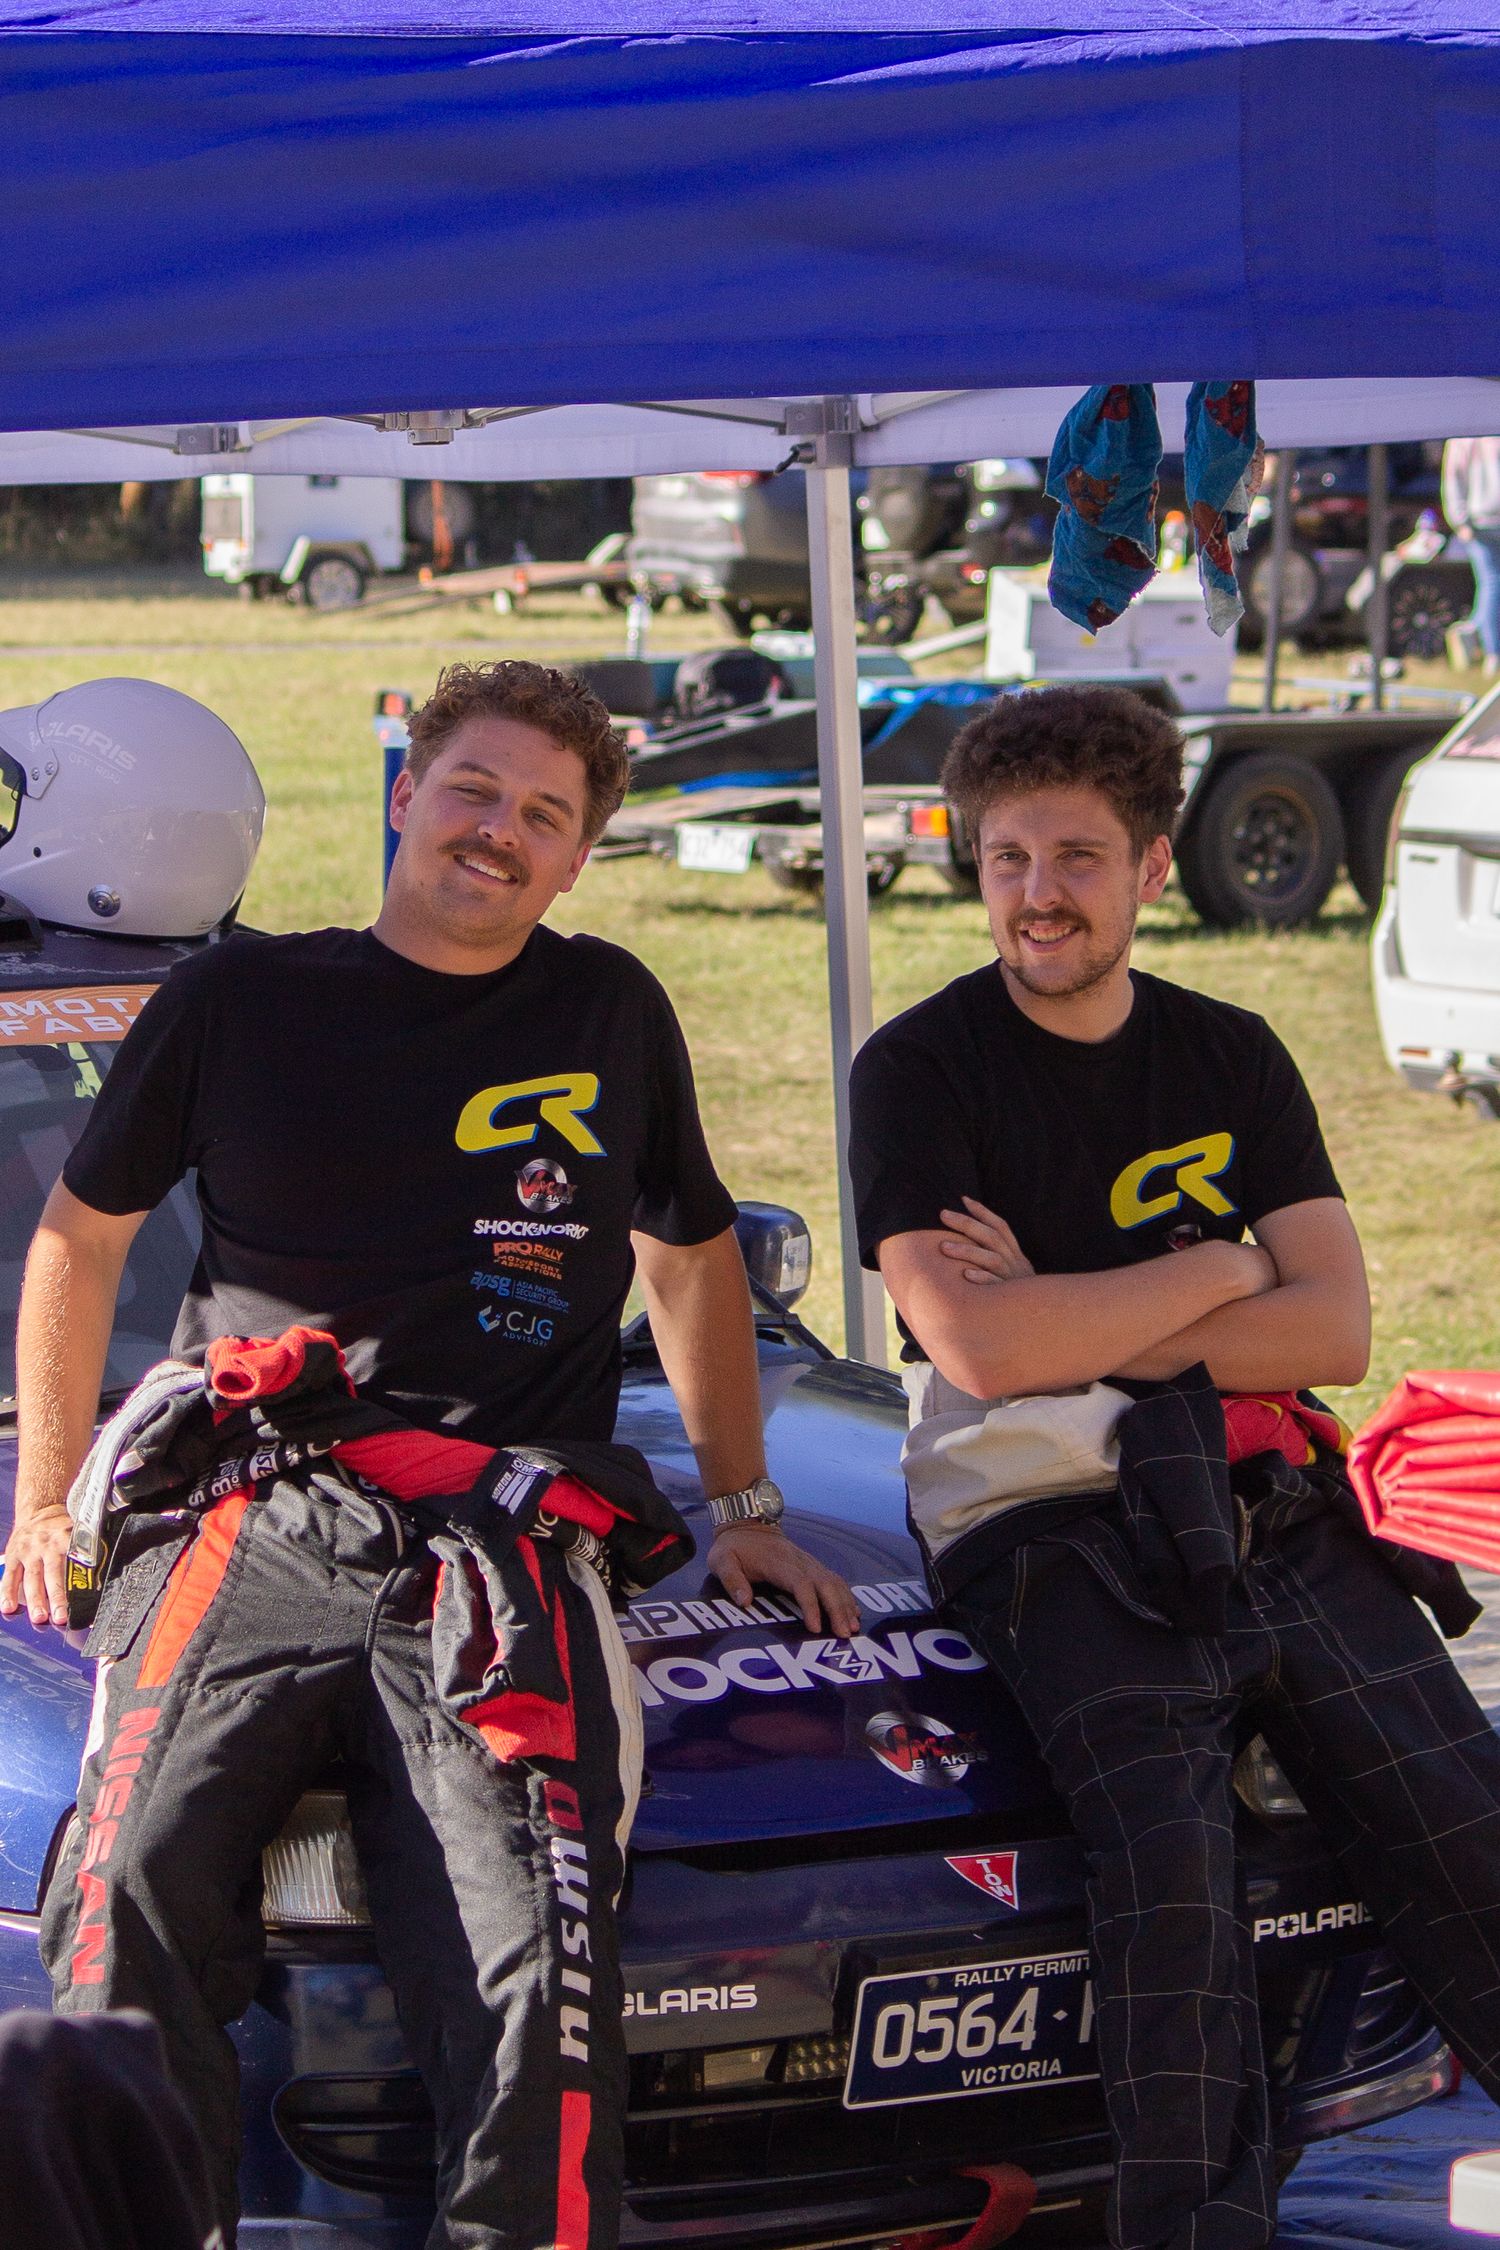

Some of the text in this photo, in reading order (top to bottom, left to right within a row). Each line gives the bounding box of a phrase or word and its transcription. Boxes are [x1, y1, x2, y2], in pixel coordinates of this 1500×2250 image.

[0, 1015, 137, 1036] FAB
[455, 1073, 607, 1157] CR
[1110, 1132, 1240, 1230] CR
[507, 1311, 554, 1340] CJG
[72, 1707, 161, 1984] NISSAN
[976, 1858, 1013, 1898] TOW
[543, 1779, 592, 2063] nismo
[954, 1966, 1014, 1988] RALLY
[961, 2058, 1062, 2087] VICTORIA
